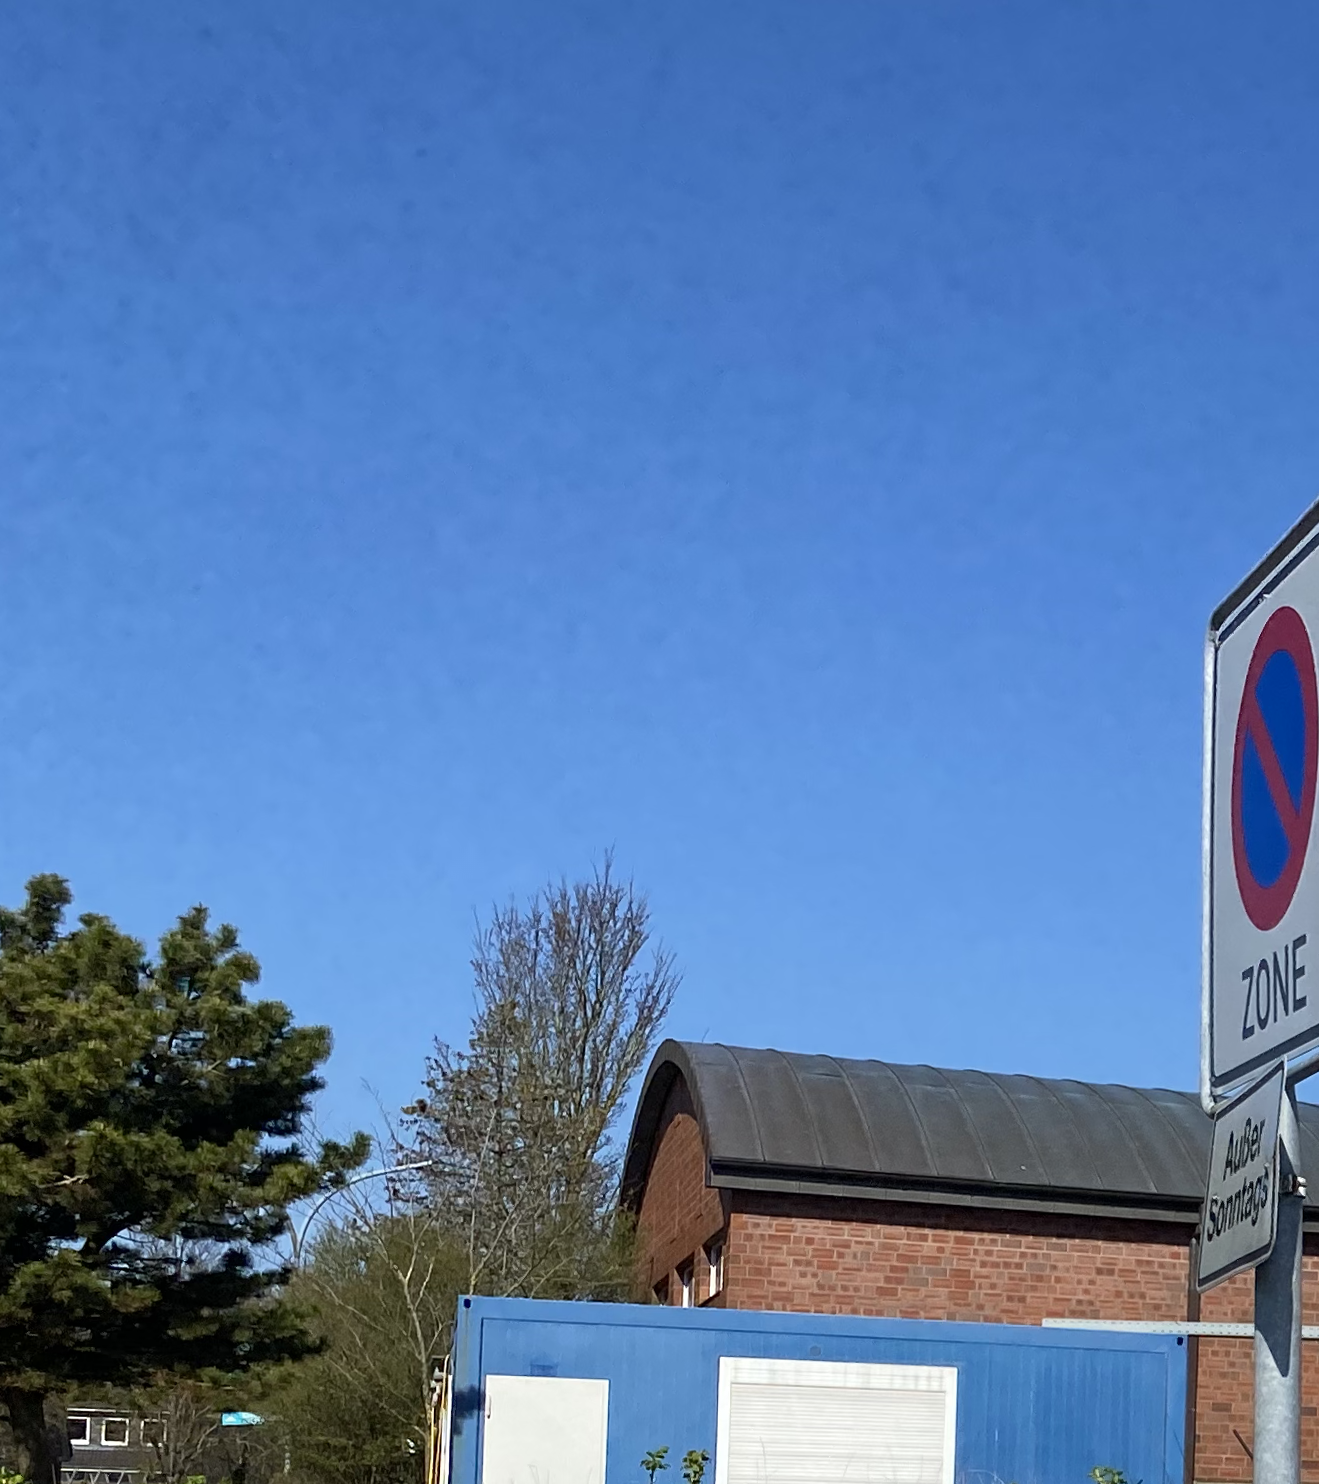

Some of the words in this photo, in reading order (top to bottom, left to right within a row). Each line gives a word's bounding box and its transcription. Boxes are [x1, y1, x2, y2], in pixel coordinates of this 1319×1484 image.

[1241, 933, 1308, 1041] ZONE
[1222, 1117, 1266, 1182] Außer
[1206, 1165, 1270, 1242] Sonntags
